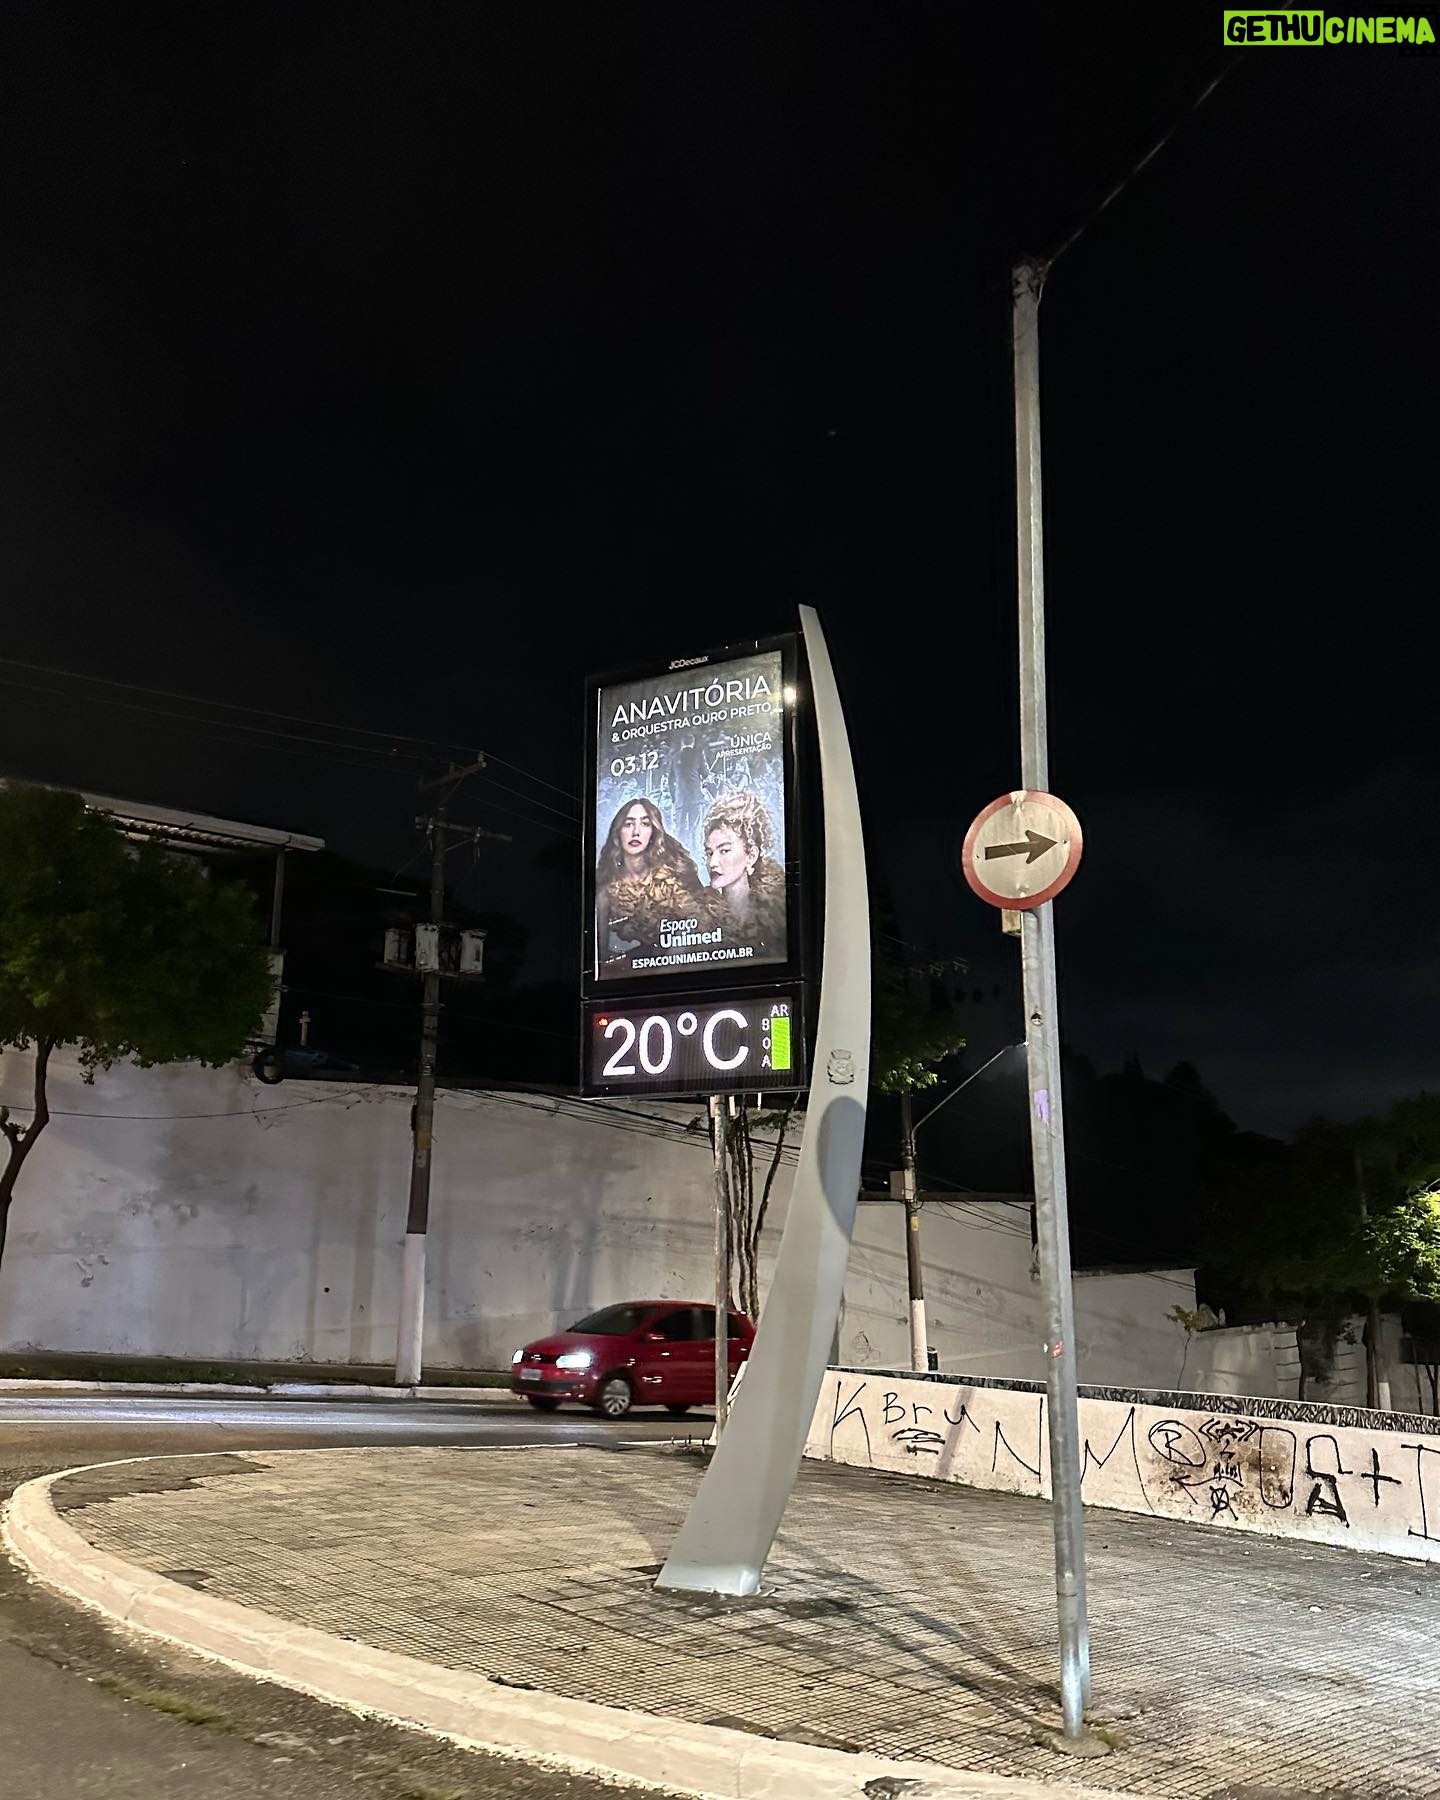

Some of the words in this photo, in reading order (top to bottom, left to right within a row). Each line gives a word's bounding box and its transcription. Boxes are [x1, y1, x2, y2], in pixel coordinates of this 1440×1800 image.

[668, 656, 709, 670] JCDecaux
[611, 675, 771, 727] ANAVITÓRIA
[611, 732, 621, 743] &
[621, 718, 690, 741] ORQUESTRA
[692, 710, 727, 727] OURO
[730, 702, 772, 720] PRETO
[731, 731, 772, 748] ÚNICA
[716, 743, 772, 758] APRESENTAÇÃO
[610, 751, 659, 777] 03.12
[660, 918, 698, 936] Espaço
[659, 928, 722, 948] Unimed
[632, 947, 753, 969] ESPACOUNIMED.COM.BR
[770, 1004, 788, 1016] AR
